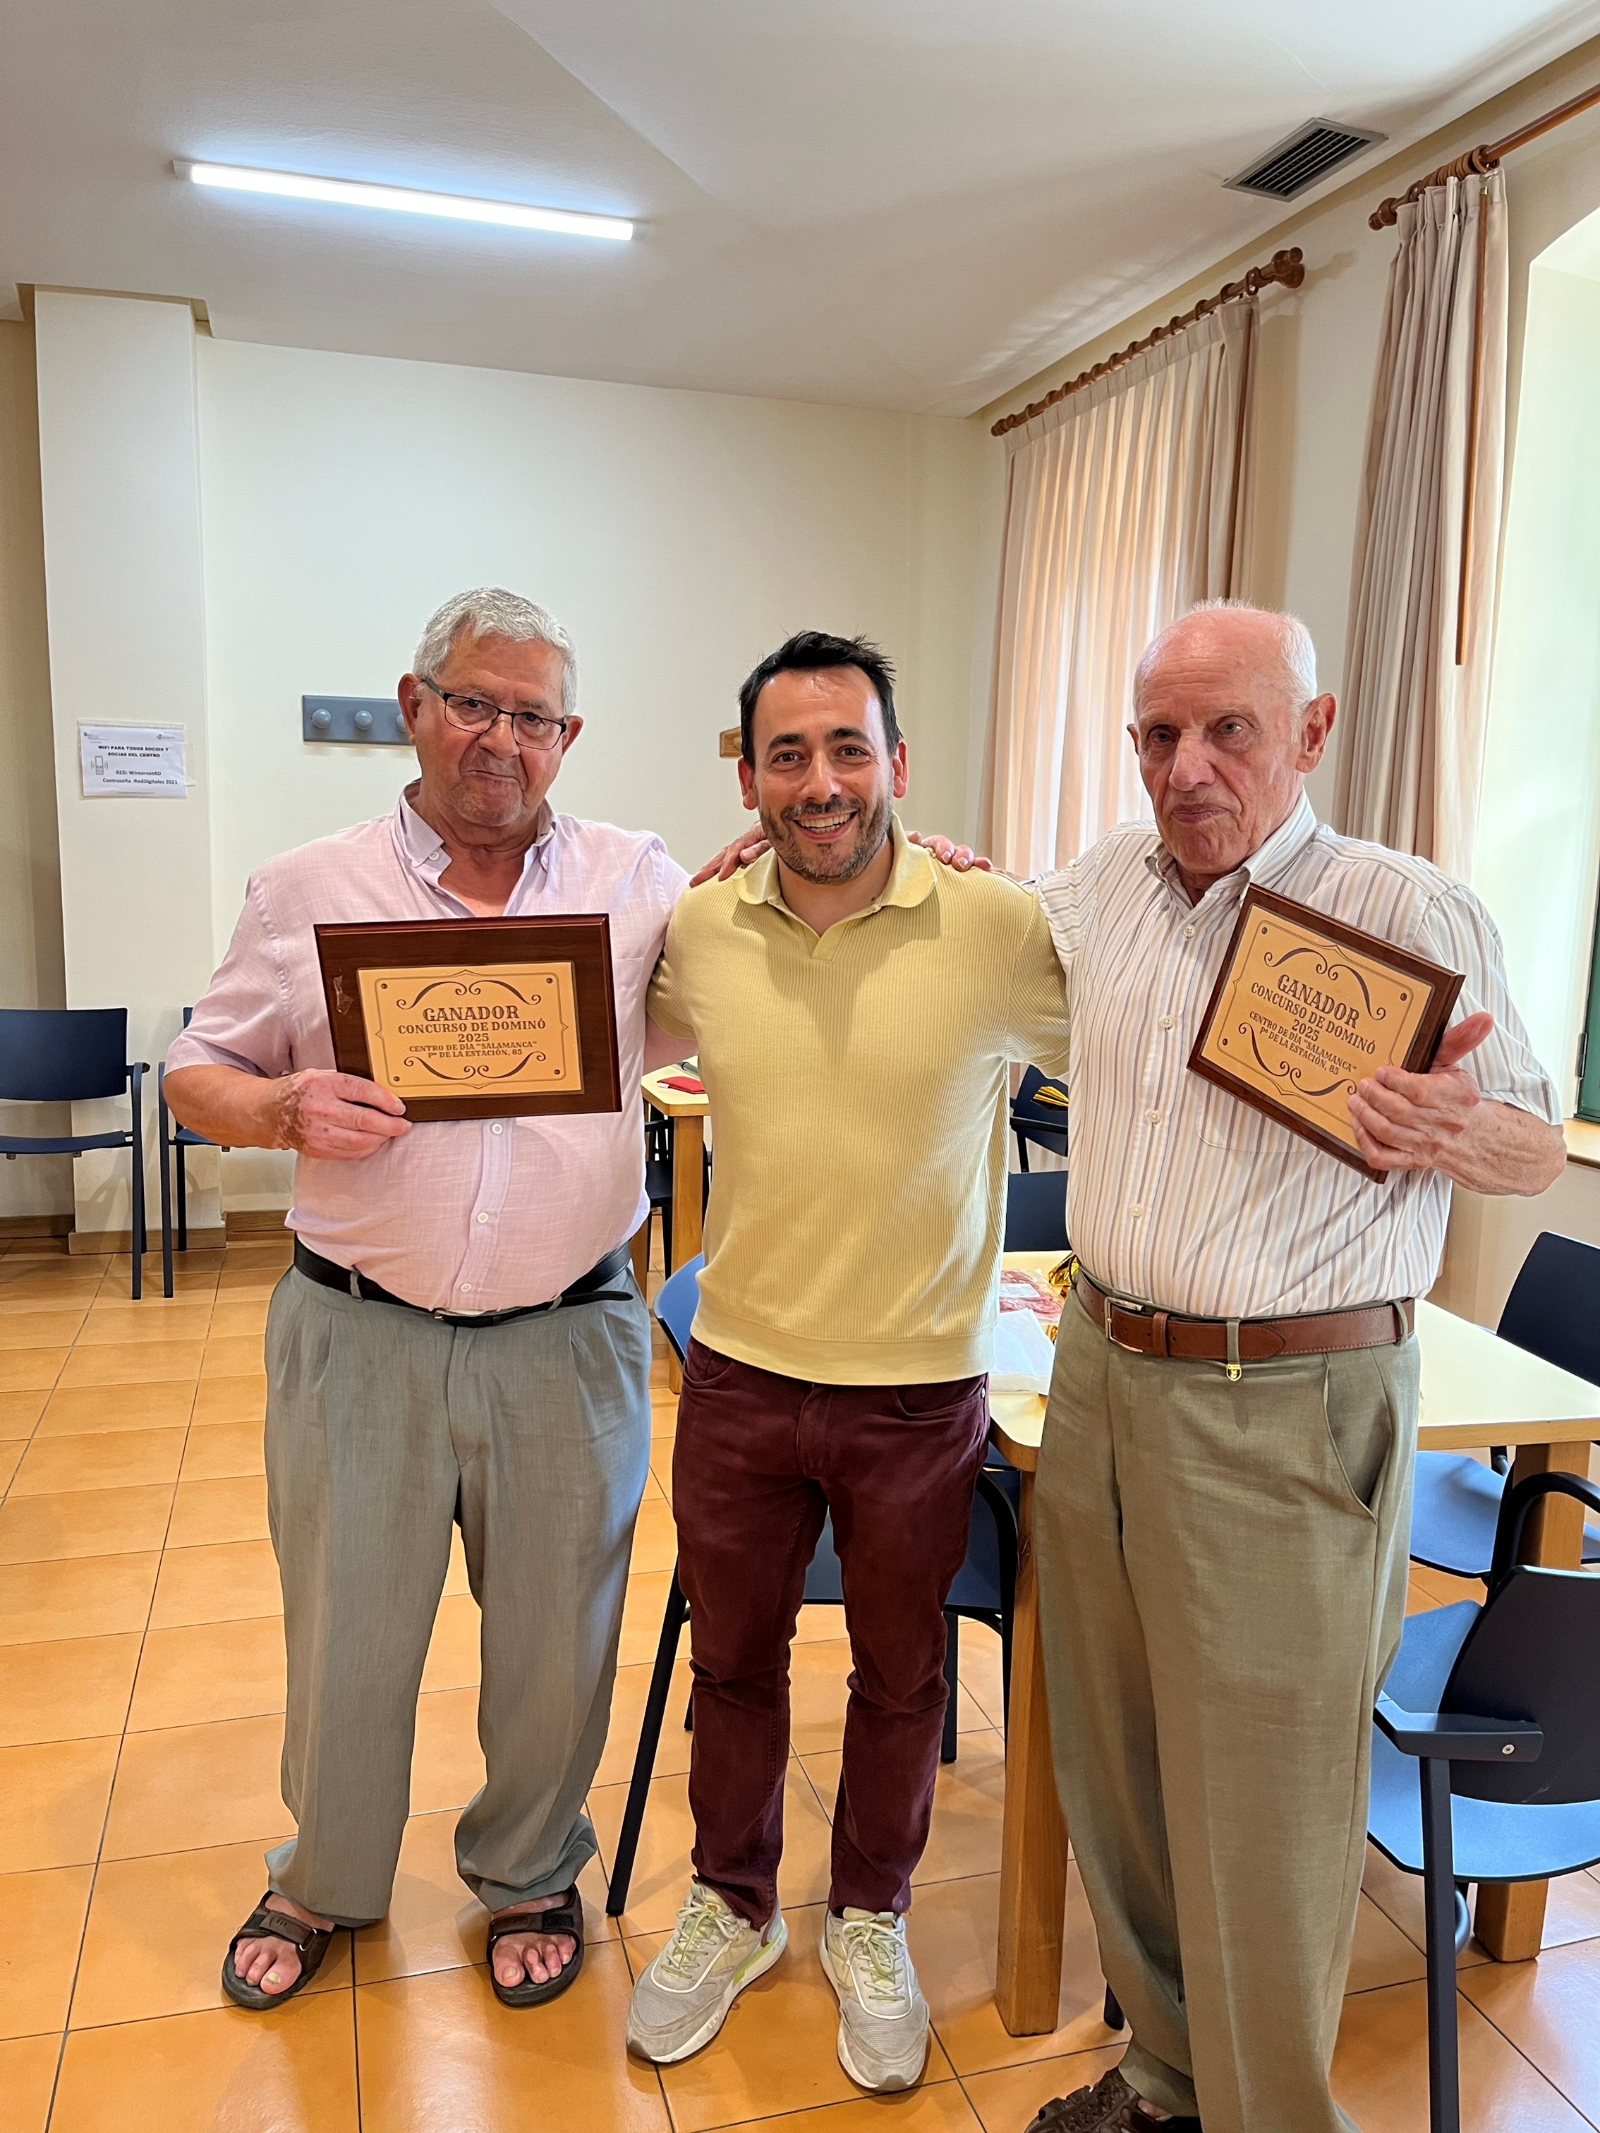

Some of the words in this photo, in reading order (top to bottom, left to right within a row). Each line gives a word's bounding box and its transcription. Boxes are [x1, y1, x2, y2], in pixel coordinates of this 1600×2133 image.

[1277, 974, 1360, 1029] GANADOR
[422, 1005, 520, 1022] GANADOR
[1251, 982, 1307, 1019] CONCURSO
[1308, 1011, 1326, 1029] DE
[1325, 1021, 1376, 1055] DOMINÓ
[398, 1022, 467, 1034] CONCURSO
[471, 1021, 489, 1032] DE
[491, 1018, 546, 1031] DOMINÓ
[1291, 1019, 1320, 1042] 2025
[457, 1033, 489, 1043] 2025
[460, 1042, 475, 1050] DÍA
[476, 1041, 537, 1050] "SALAMANCA"
[1249, 1011, 1278, 1031] CENTRO
[1278, 1027, 1288, 1038] DE
[1288, 1031, 1302, 1045] DÍA
[1303, 1040, 1357, 1072] "SALAMANCA"
[465, 1048, 510, 1057] ESTACIÓN,
[1268, 1031, 1279, 1043] DE
[1279, 1037, 1288, 1049] LA
[1289, 1042, 1327, 1071] ESTACIÓN,
[1328, 1064, 1340, 1075] 85
